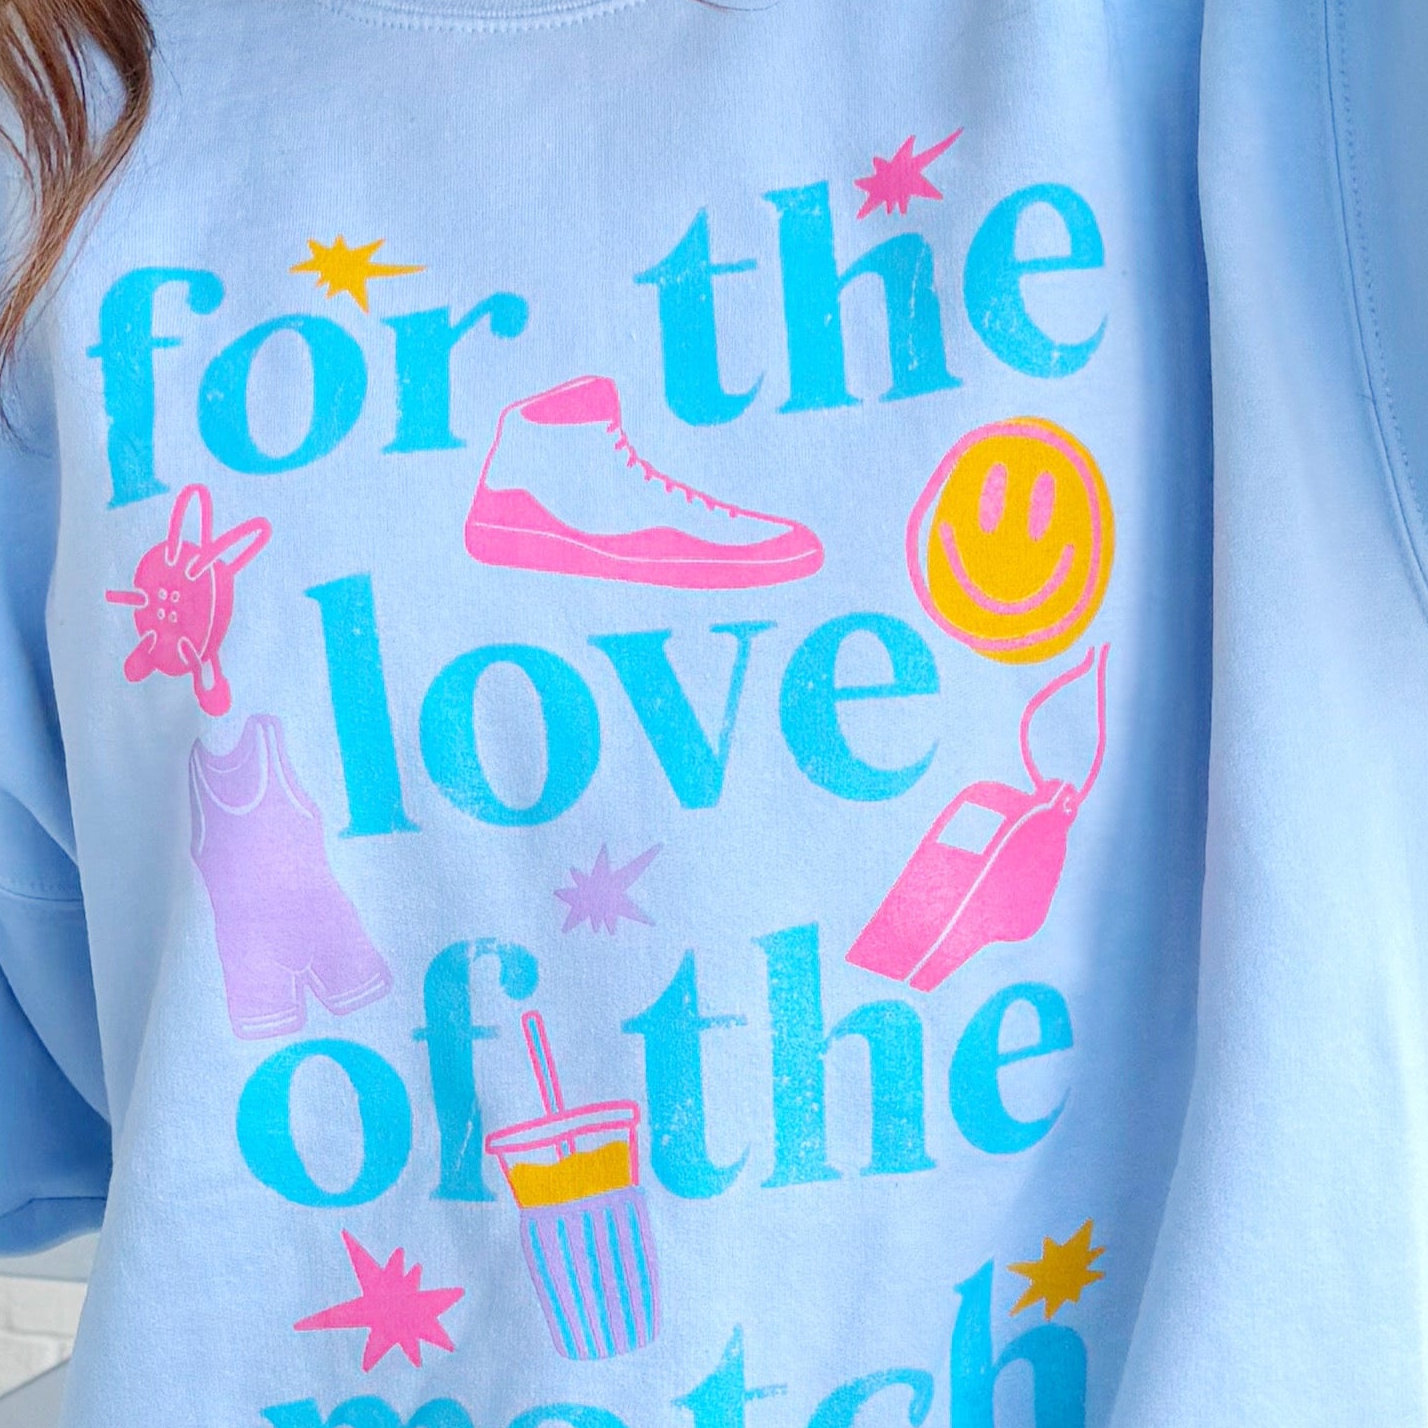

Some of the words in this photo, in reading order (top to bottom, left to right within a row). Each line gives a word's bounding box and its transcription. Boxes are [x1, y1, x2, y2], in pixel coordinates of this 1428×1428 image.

[85, 265, 530, 510] for
[633, 179, 1106, 428] the
[303, 572, 940, 839] love
[235, 937, 541, 1210] of
[620, 922, 1075, 1202] the
